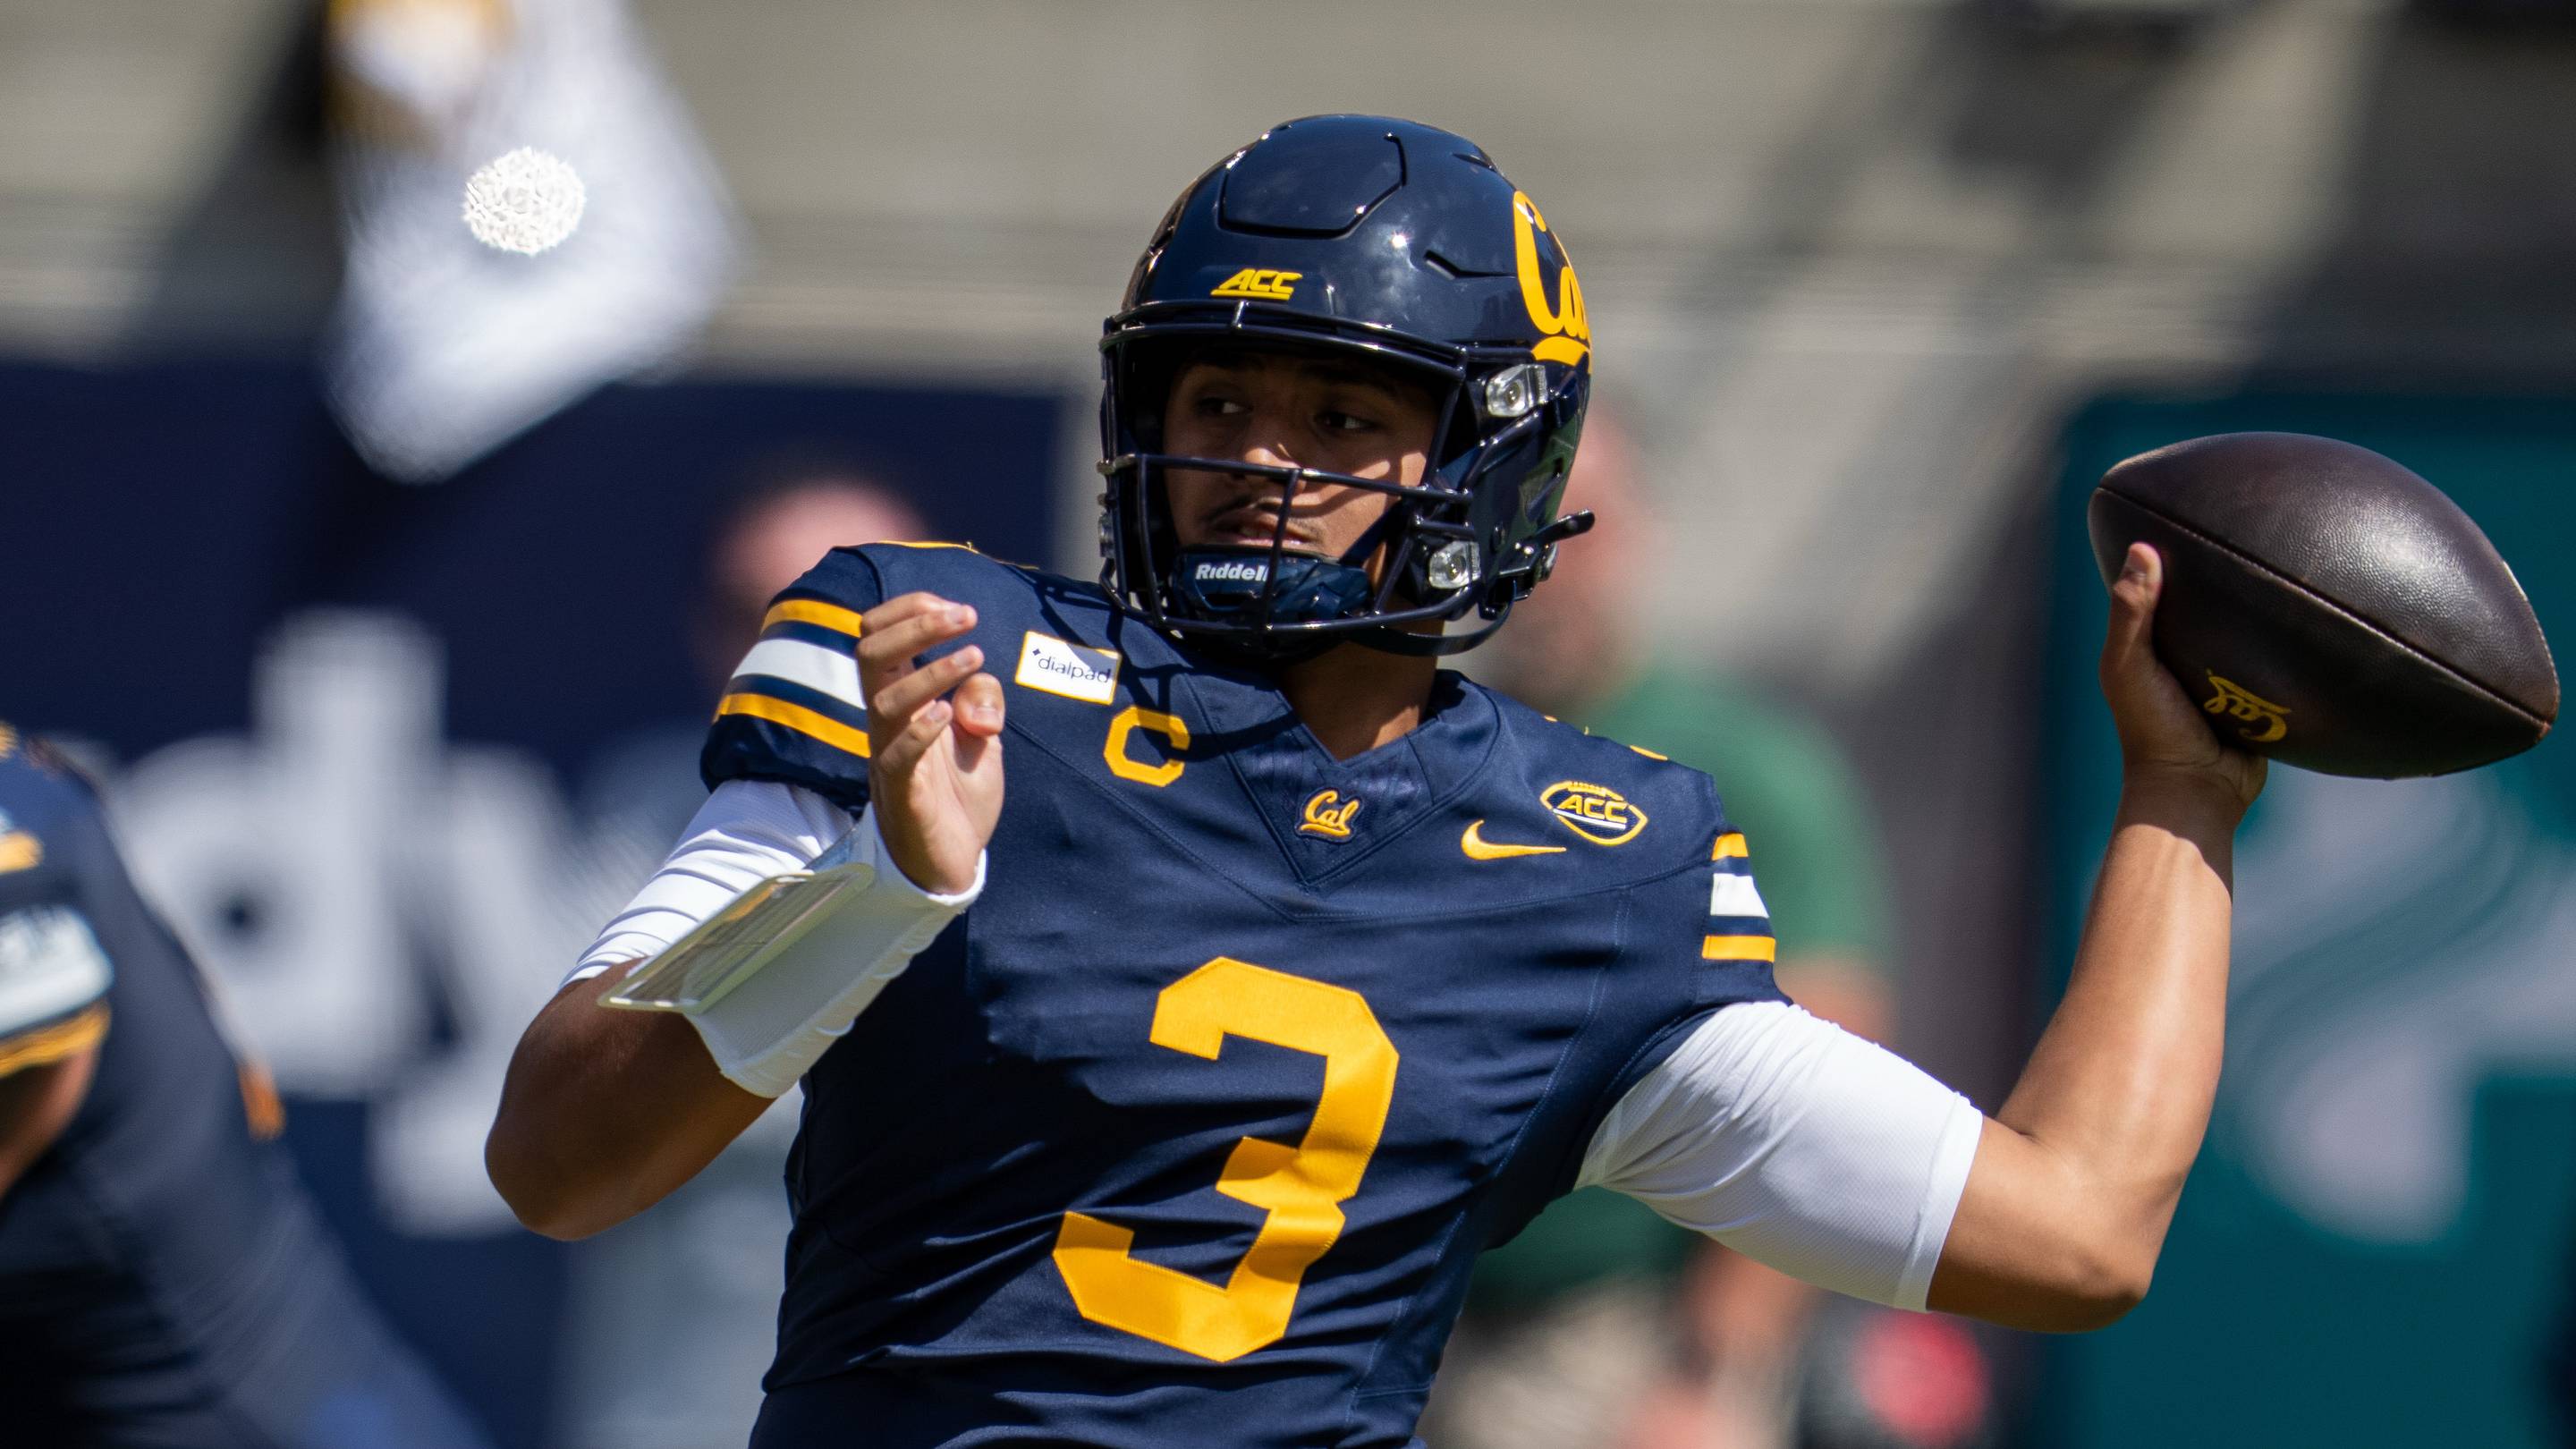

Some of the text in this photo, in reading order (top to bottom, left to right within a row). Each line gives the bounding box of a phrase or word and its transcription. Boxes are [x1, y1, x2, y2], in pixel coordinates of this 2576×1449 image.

[1216, 268, 1303, 295] ACC
[1513, 190, 1592, 370] Ca
[1038, 656, 1112, 683] dialpad
[1103, 704, 1191, 787] C
[1300, 790, 1360, 836] Cal
[1556, 793, 1629, 824] ACC
[1052, 955, 1401, 1364] 3
